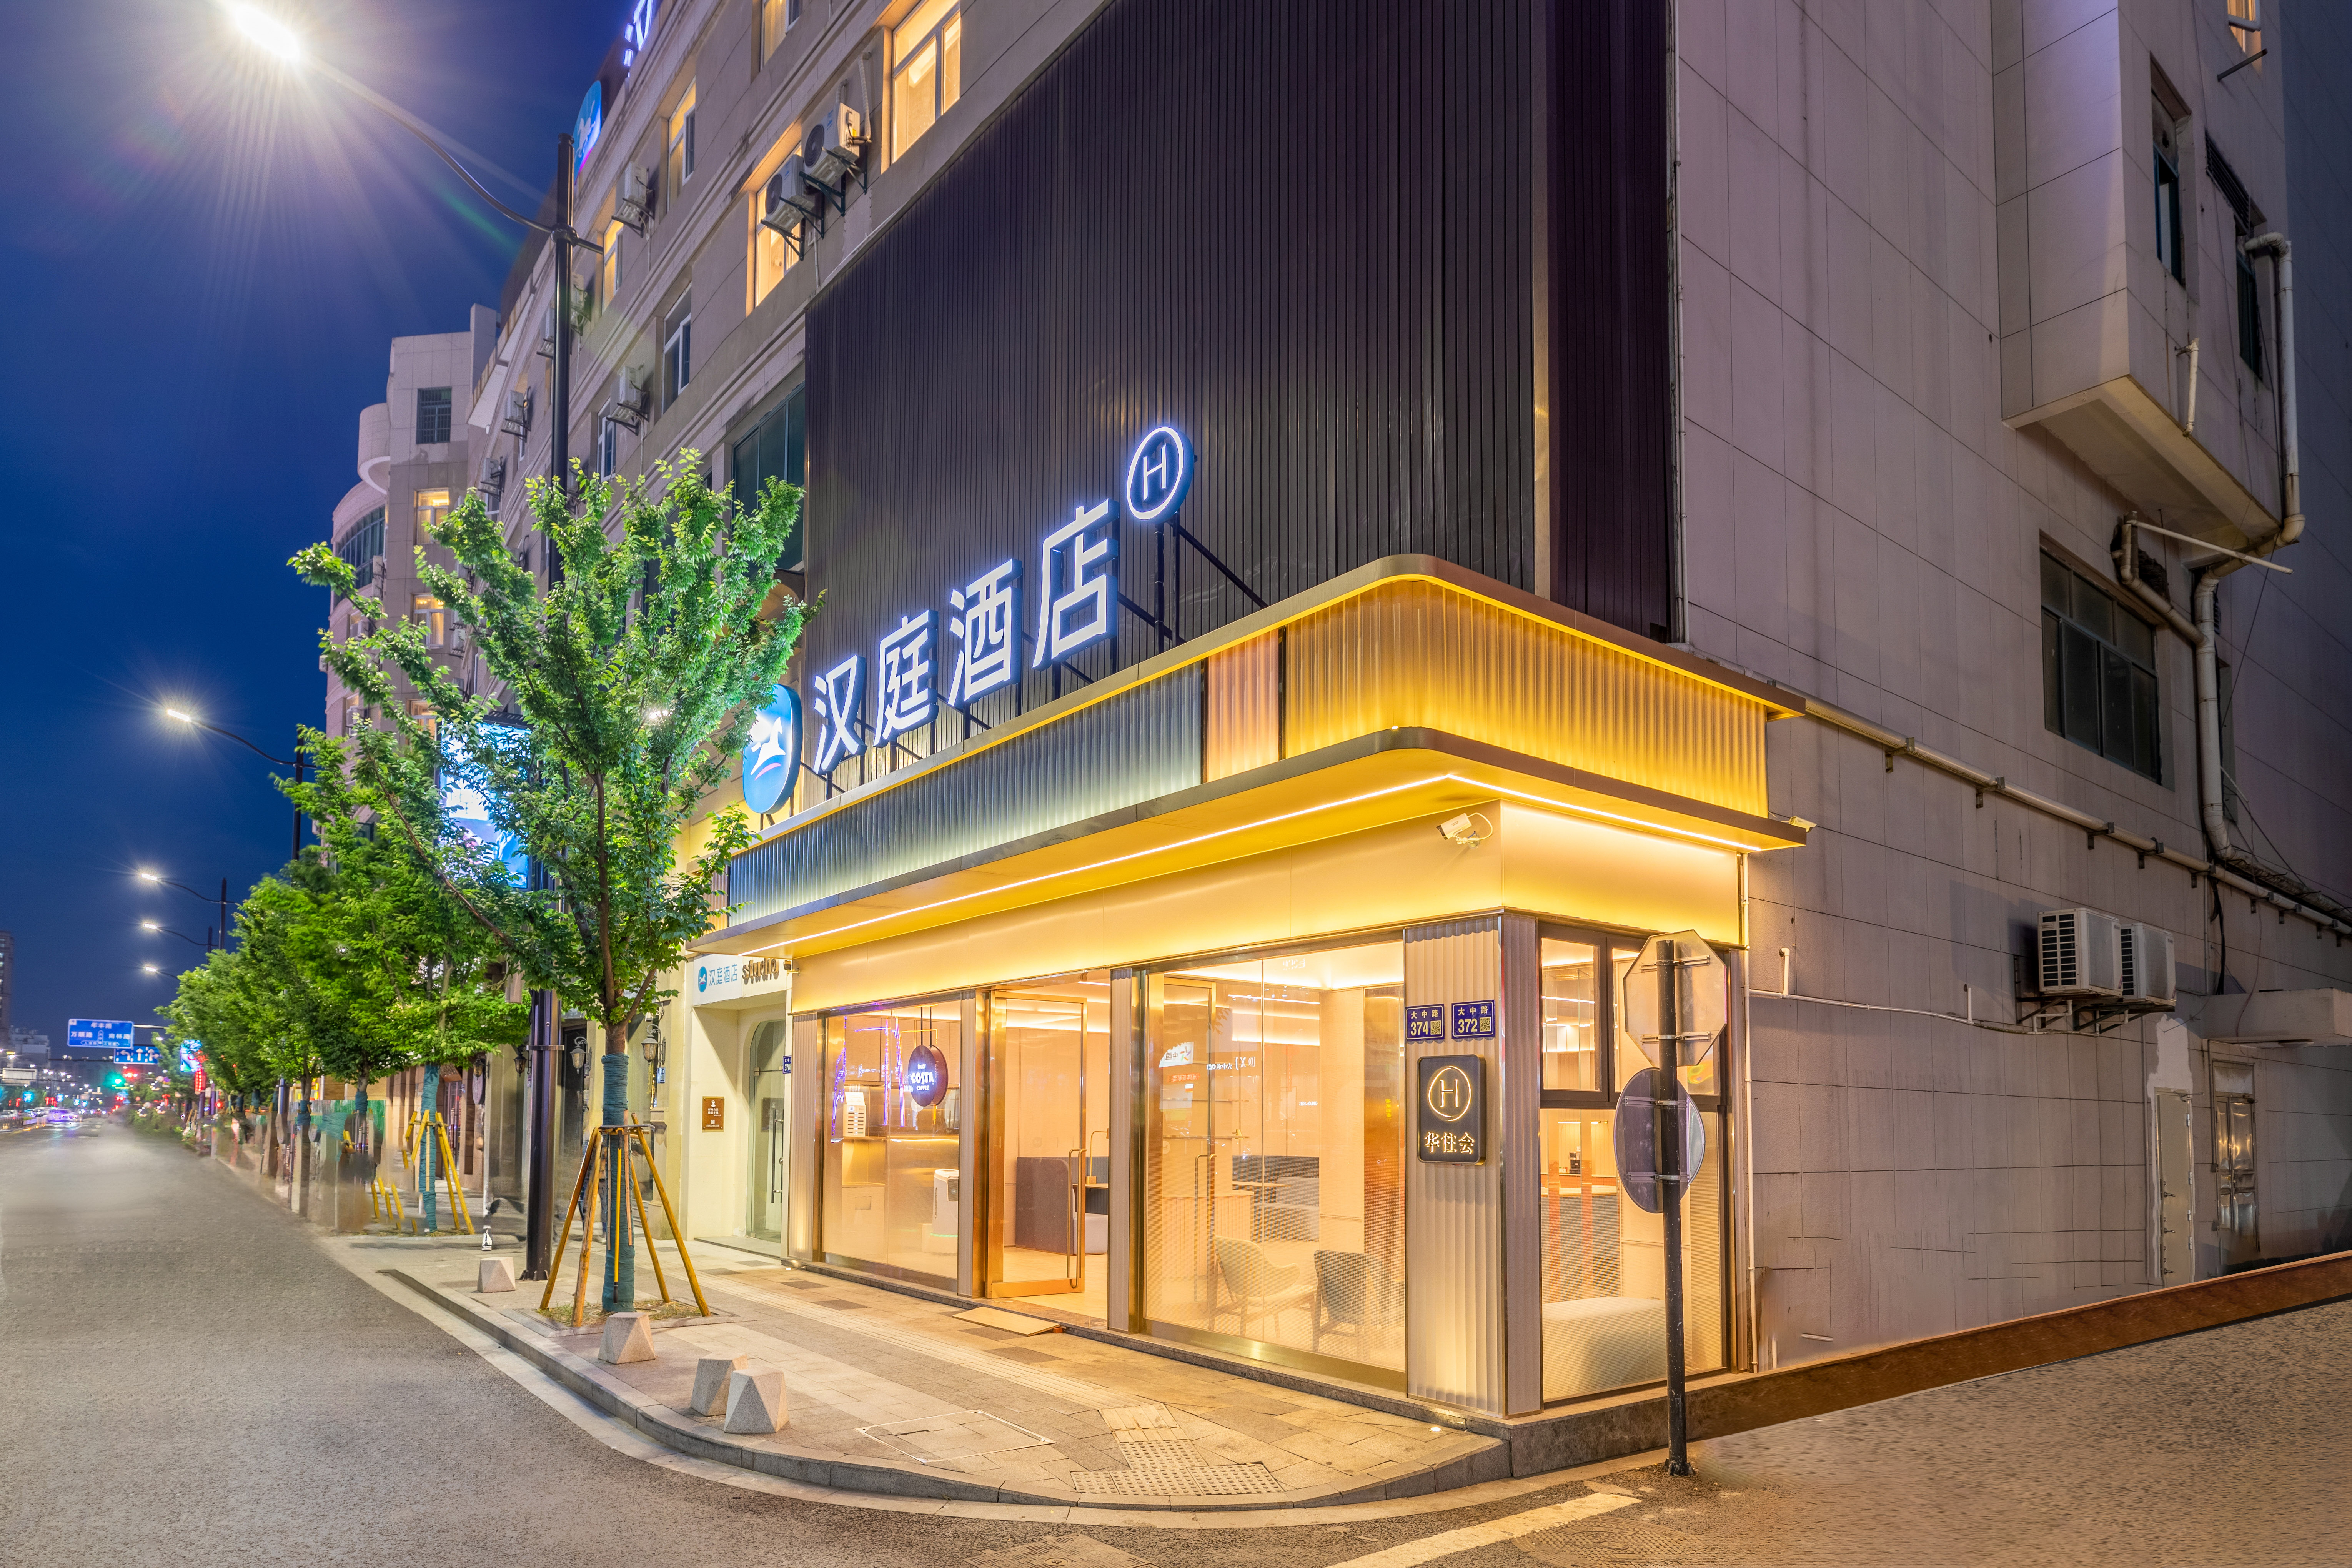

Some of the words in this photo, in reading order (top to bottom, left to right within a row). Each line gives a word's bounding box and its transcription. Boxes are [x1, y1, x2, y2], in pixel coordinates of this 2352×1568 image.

[813, 498, 1119, 774] 汉庭酒店
[709, 964, 737, 986] 汉庭酒店
[1410, 1009, 1439, 1019] 大中路
[1458, 1005, 1488, 1016] 大中路
[1410, 1021, 1429, 1036] 374
[1458, 1018, 1478, 1034] 372
[911, 1072, 934, 1085] COSTA
[1424, 1131, 1475, 1155] 华住会
